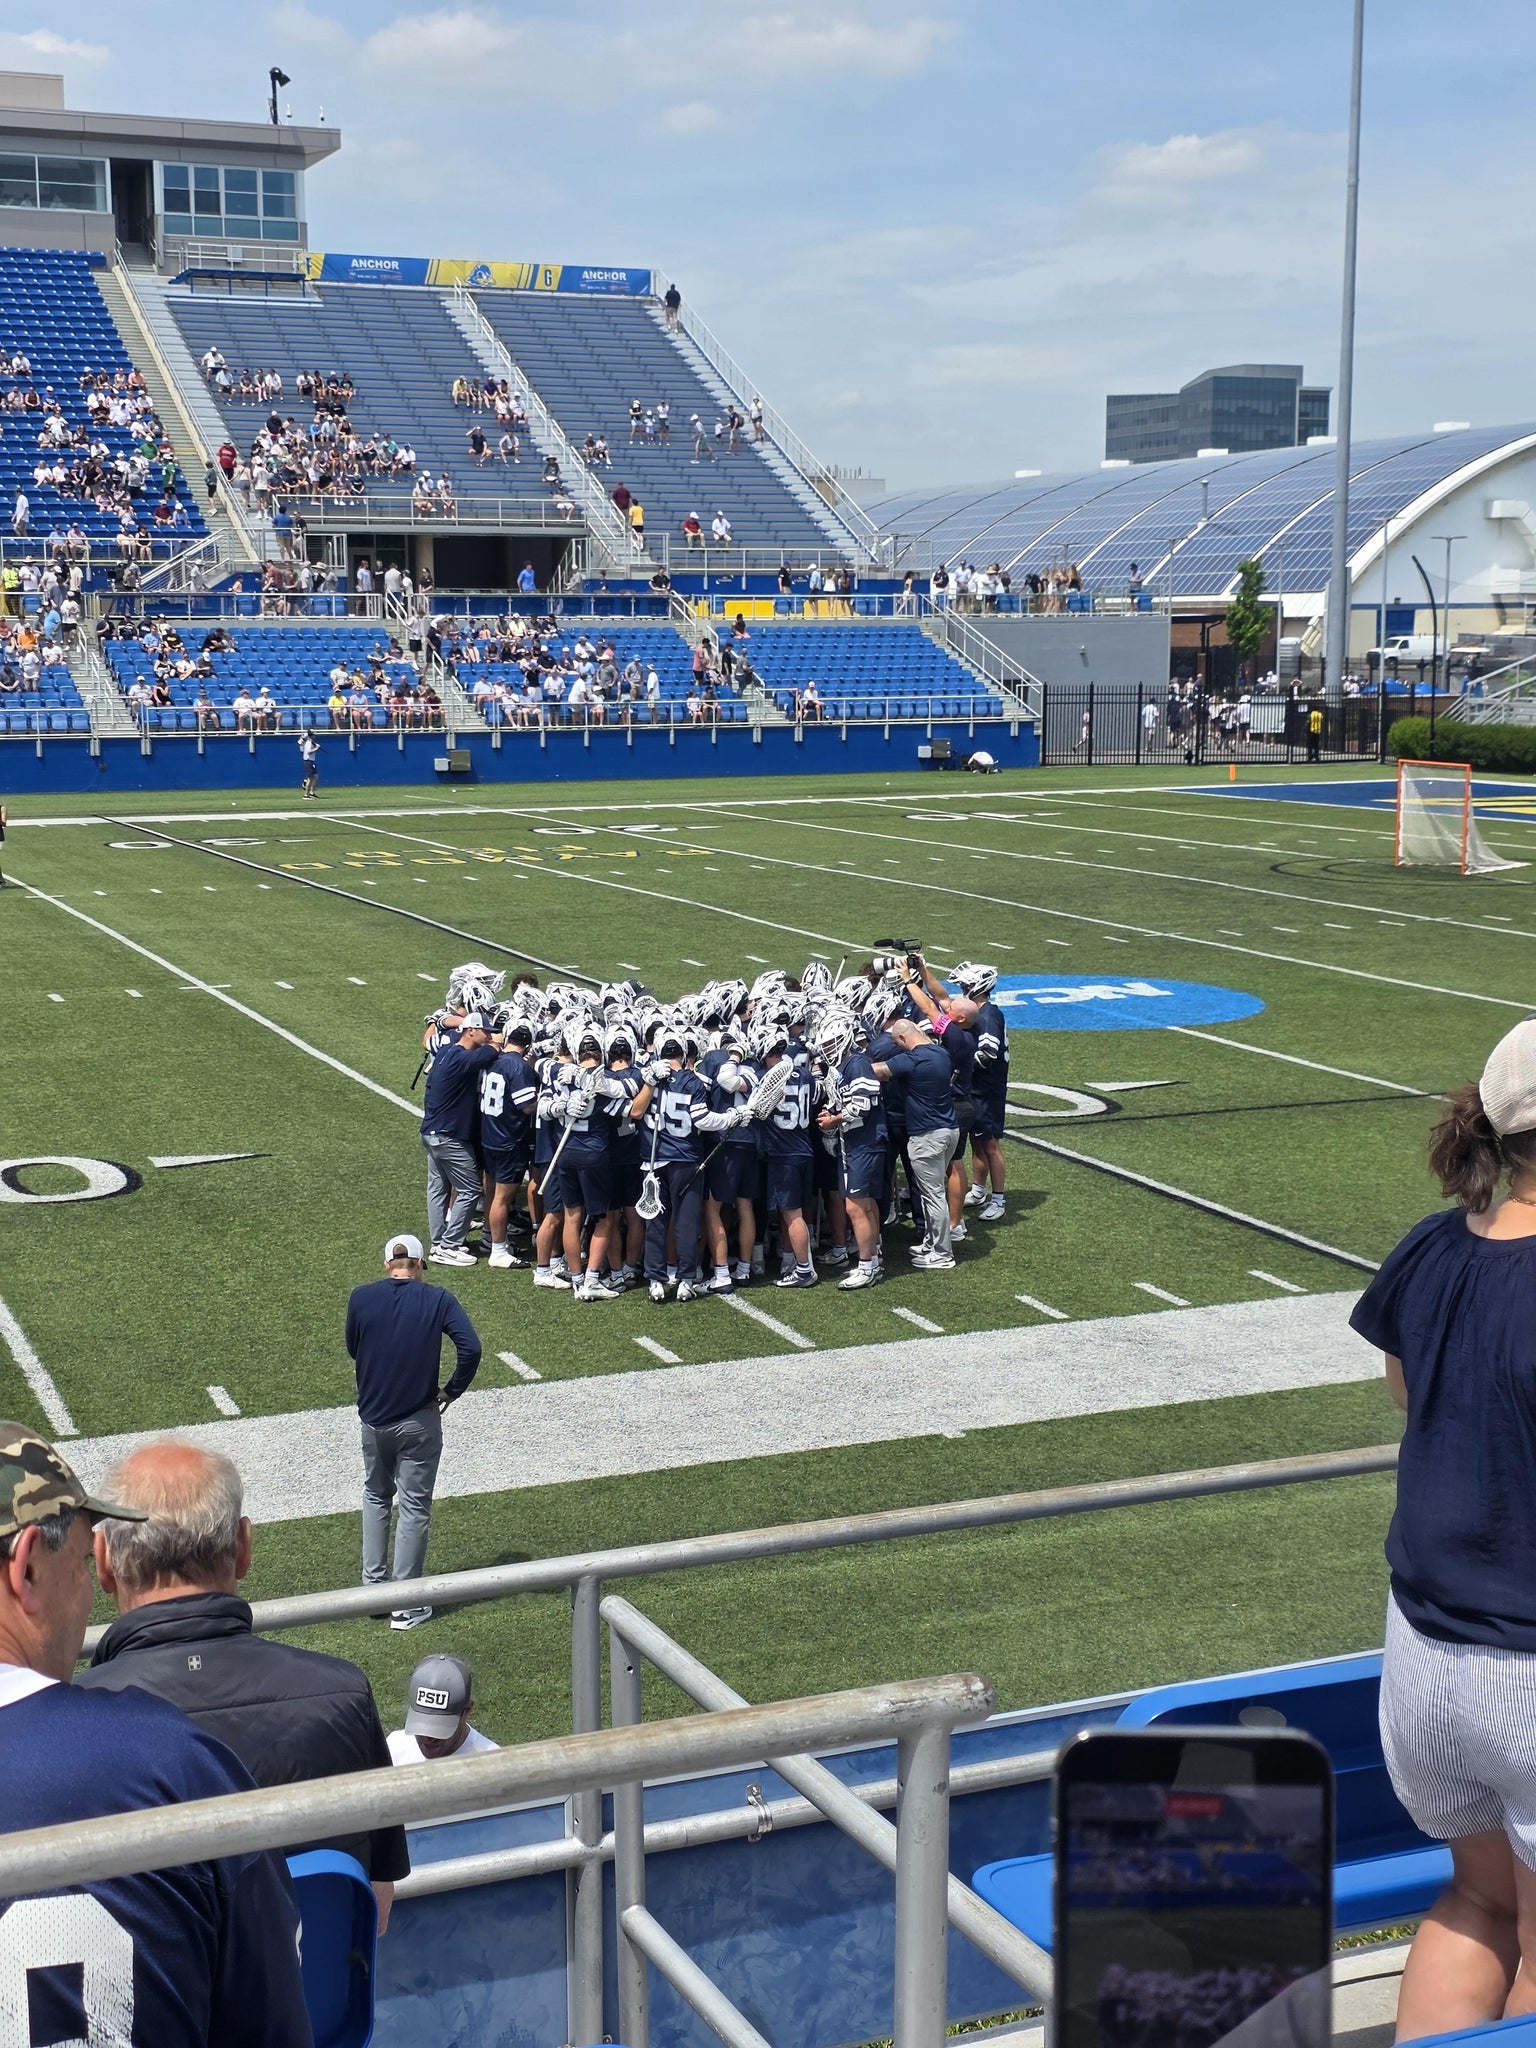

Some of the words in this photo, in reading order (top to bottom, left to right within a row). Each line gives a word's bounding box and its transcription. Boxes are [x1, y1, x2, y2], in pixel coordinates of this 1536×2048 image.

[351, 259, 399, 270] ANCHOR
[544, 269, 552, 287] G
[582, 270, 627, 281] ANCHOR
[773, 1083, 811, 1130] 50
[418, 1690, 447, 1706] PSU
